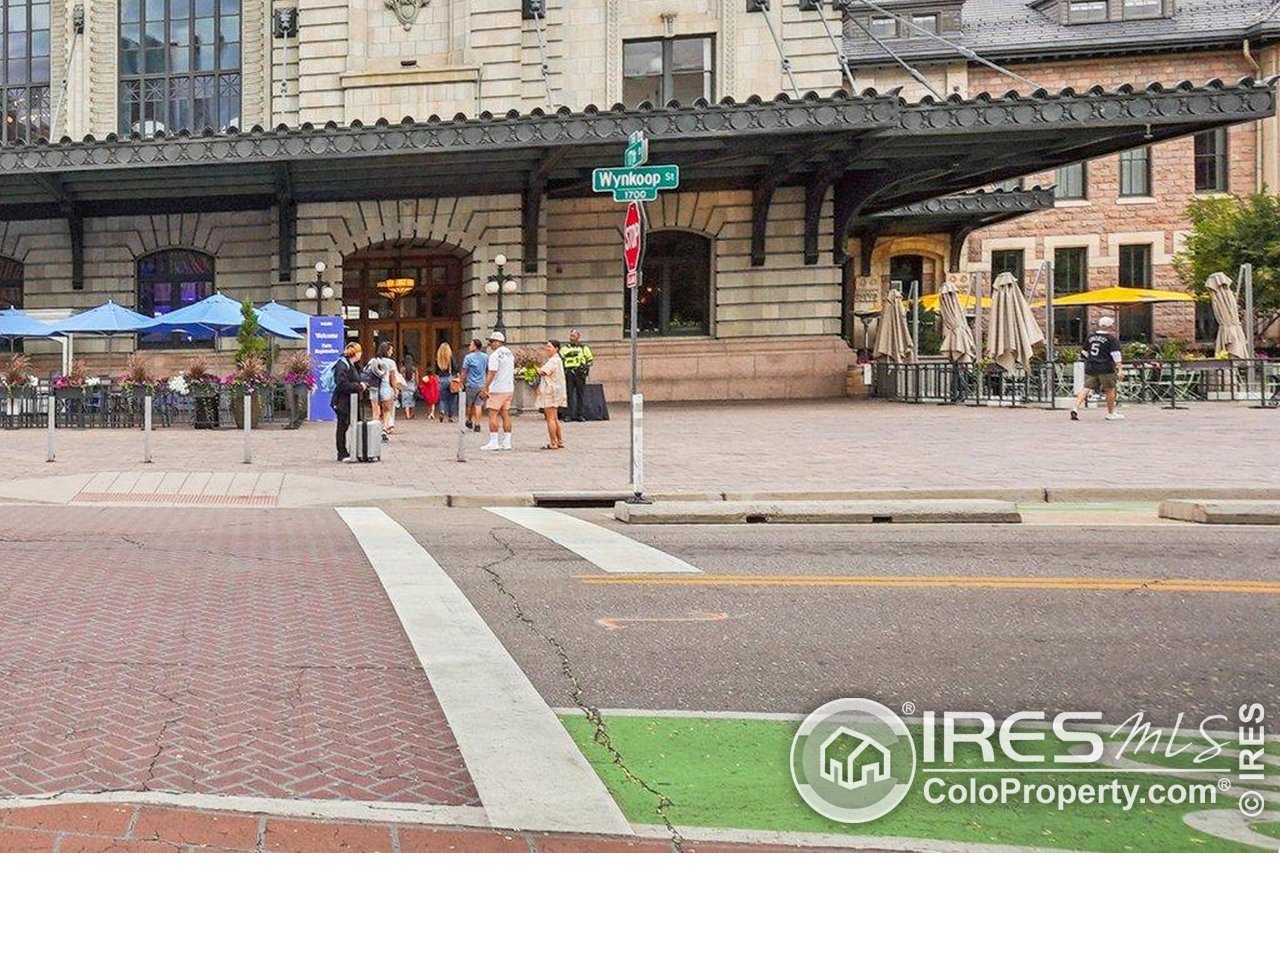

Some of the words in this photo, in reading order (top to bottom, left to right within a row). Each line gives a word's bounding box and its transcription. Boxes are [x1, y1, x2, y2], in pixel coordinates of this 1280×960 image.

[599, 171, 661, 188] Wynkoop
[665, 173, 675, 182] St
[624, 191, 647, 199] 1700
[1090, 342, 1101, 356] 5
